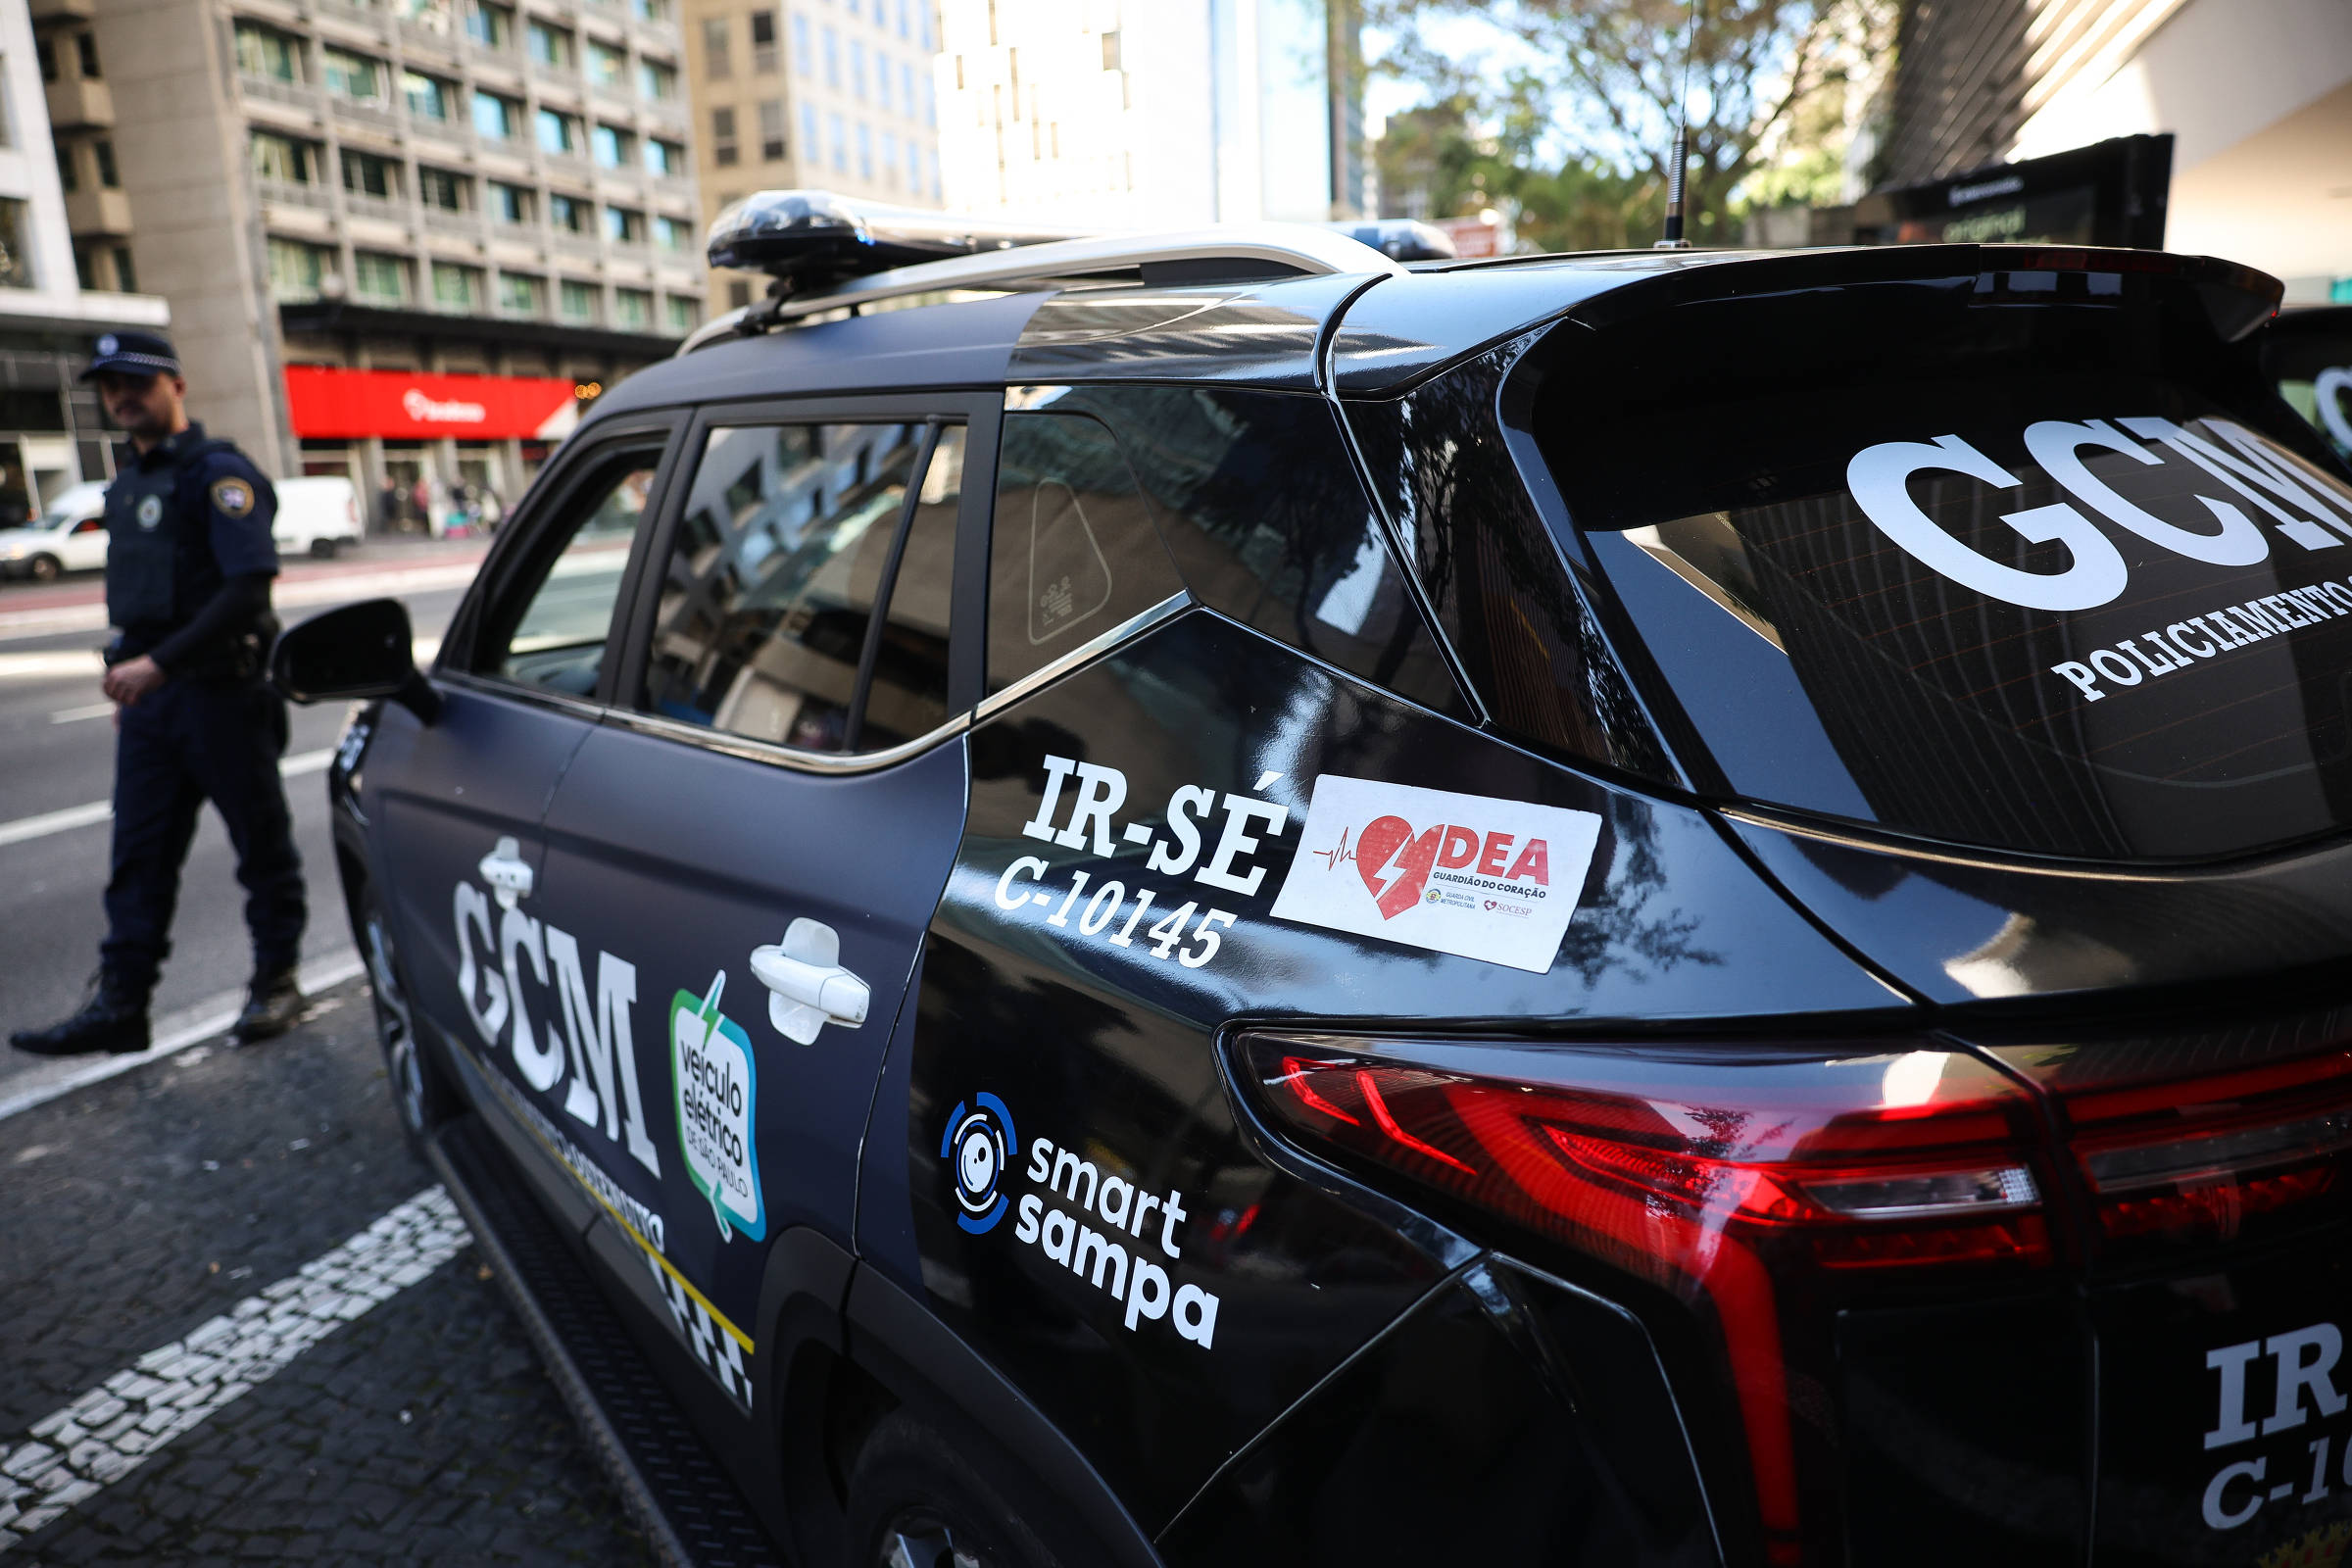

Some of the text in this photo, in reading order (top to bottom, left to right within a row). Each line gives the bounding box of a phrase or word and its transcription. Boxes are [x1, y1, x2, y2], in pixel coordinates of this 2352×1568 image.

[1846, 416, 2352, 611] GCM
[1022, 754, 1289, 897] IR-SÉ
[994, 856, 1238, 968] C-10145
[1433, 871, 1546, 899] GUARDIÃO DO CORAÇÃO
[1446, 892, 1465, 901] GUARDA
[1496, 903, 1533, 916] SOCESP
[453, 880, 662, 1180] GCM
[683, 1081, 743, 1166] elétrico
[687, 1125, 698, 1150] DE
[716, 1155, 749, 1198] PAULO
[1026, 1137, 1187, 1259] smart
[1015, 1193, 1220, 1350] sampa
[2201, 1431, 2352, 1530] C-1
